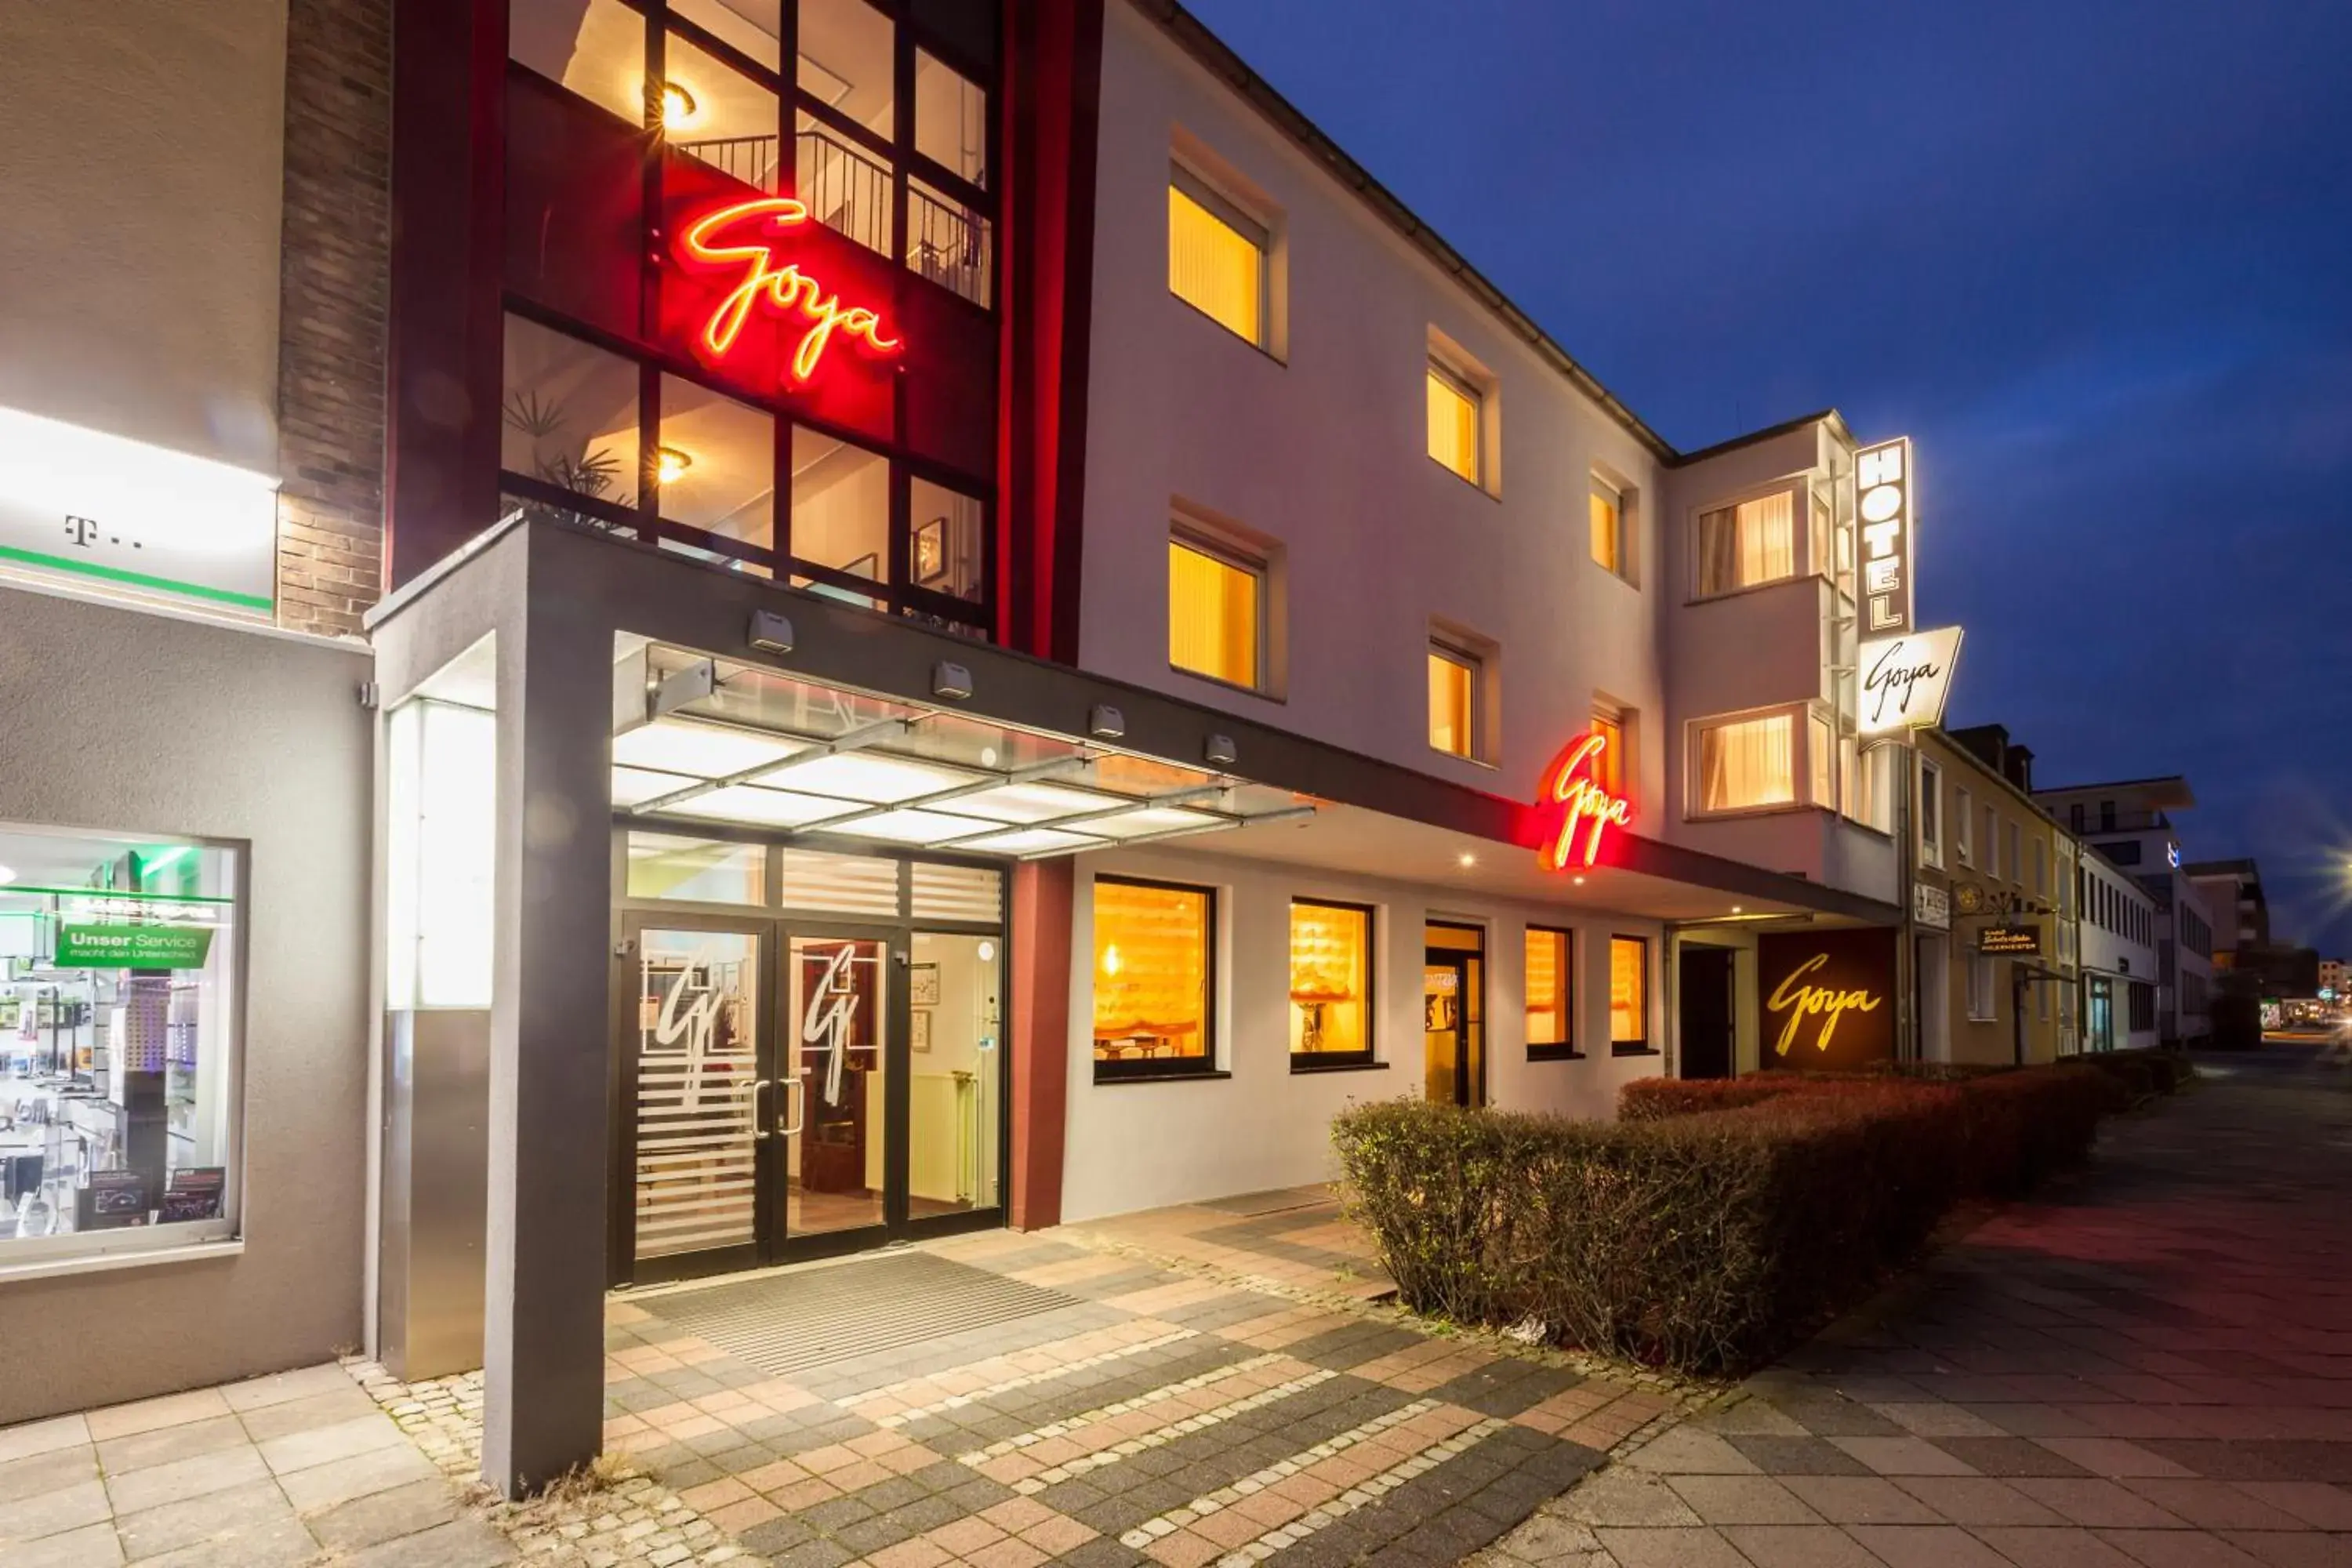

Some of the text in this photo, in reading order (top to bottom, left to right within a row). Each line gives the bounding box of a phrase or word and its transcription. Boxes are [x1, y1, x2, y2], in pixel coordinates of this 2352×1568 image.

[688, 198, 899, 380] Goya
[1858, 445, 1903, 631] HOTEL
[1864, 641, 1940, 724] Goya
[1555, 733, 1632, 869] Goya
[70, 931, 197, 949] Unser Service
[70, 949, 106, 958] macht
[1766, 953, 1882, 1057] Goya
